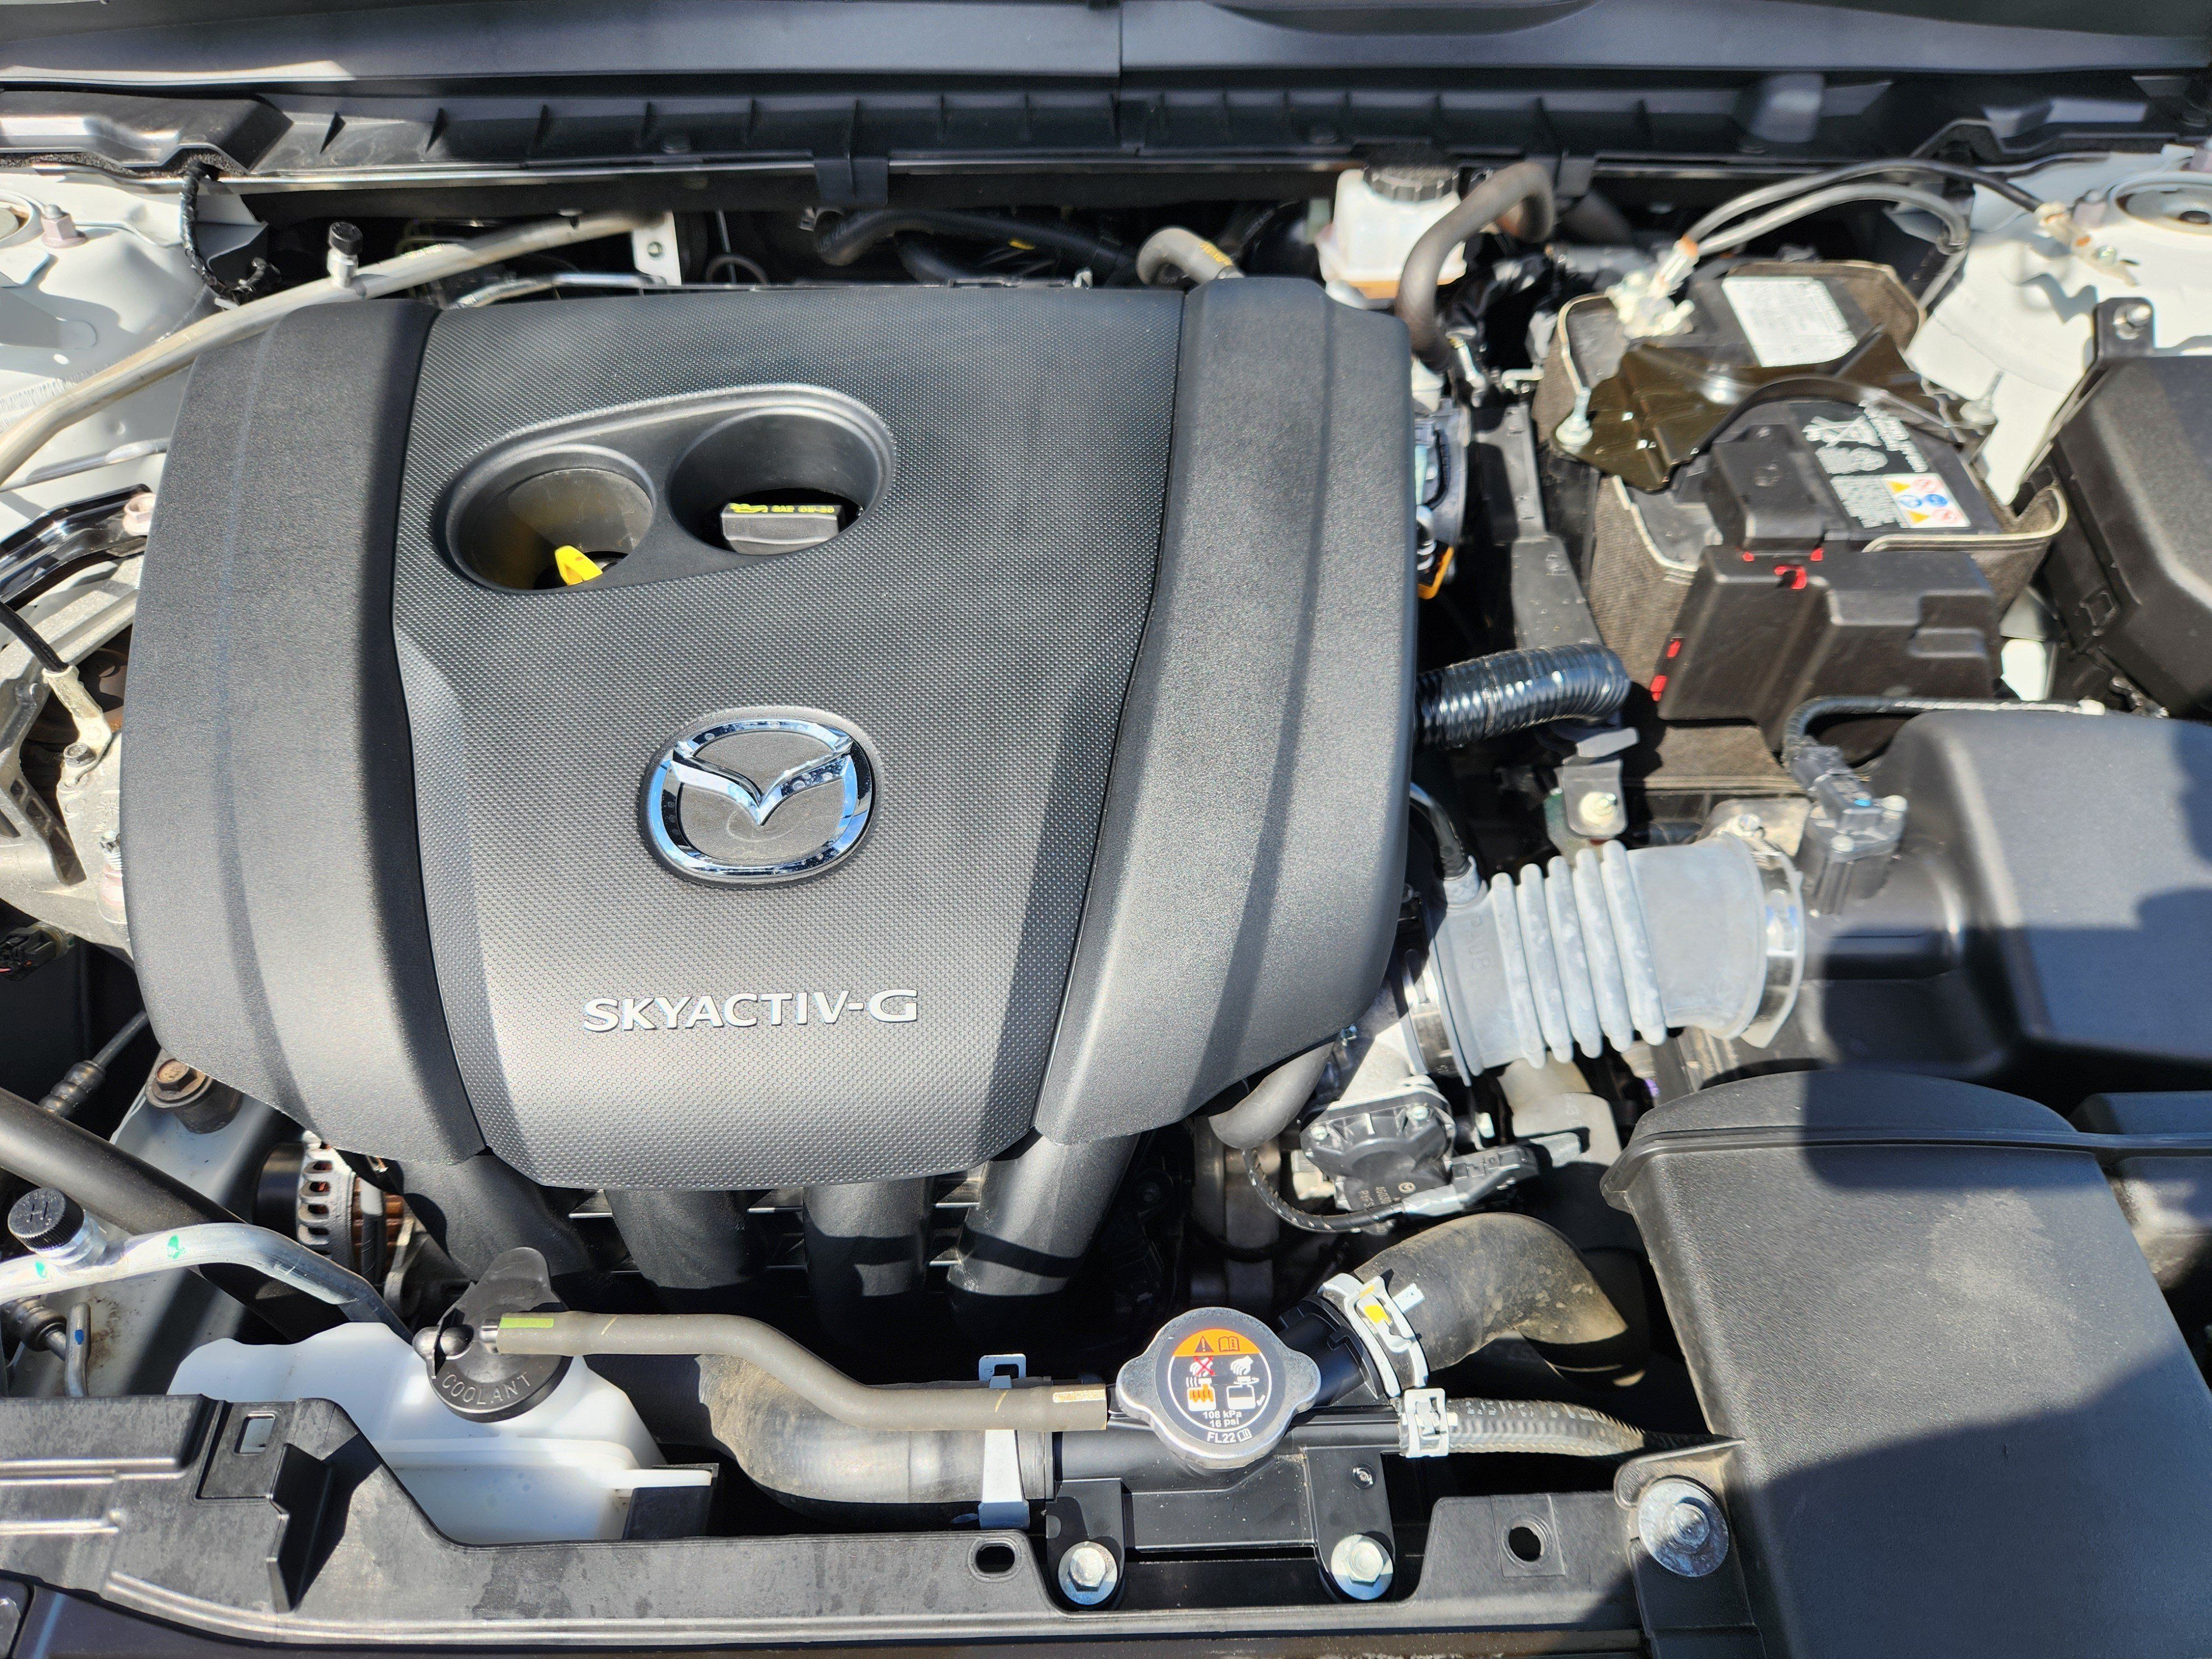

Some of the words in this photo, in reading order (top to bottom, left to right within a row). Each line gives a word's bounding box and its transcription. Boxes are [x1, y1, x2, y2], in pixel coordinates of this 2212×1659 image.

[771, 505, 795, 513] SAE
[583, 988, 918, 1032] SKYACTIV-G
[442, 1371, 532, 1406] COOLANT
[1203, 1410, 1221, 1420] 108
[1223, 1410, 1242, 1418] kPa
[1209, 1419, 1222, 1428] 16
[1224, 1417, 1239, 1427] psi
[1207, 1431, 1237, 1444] FL22
